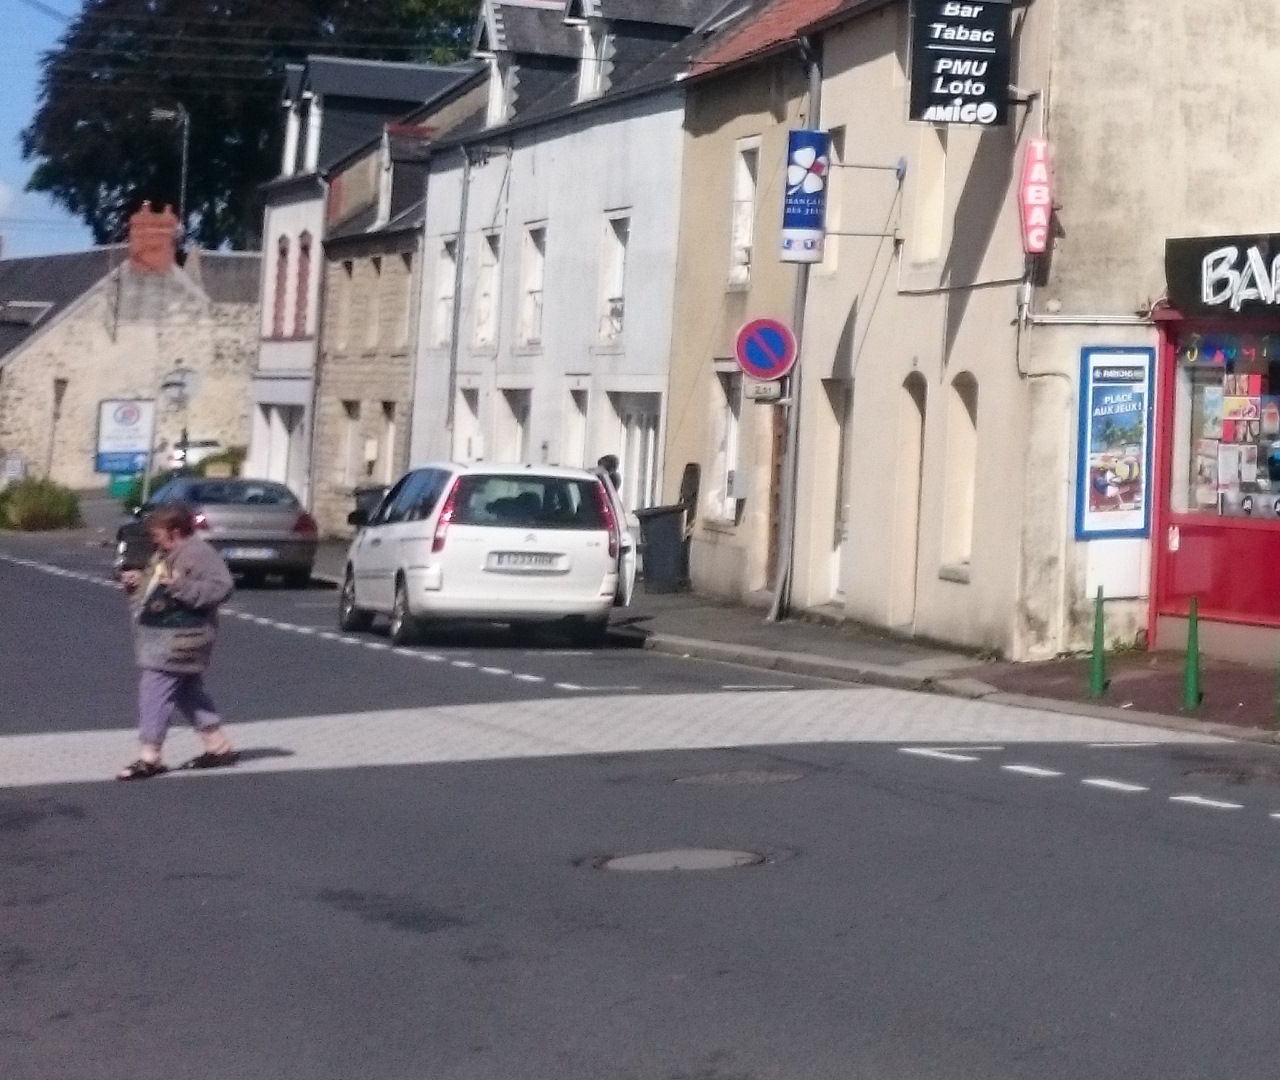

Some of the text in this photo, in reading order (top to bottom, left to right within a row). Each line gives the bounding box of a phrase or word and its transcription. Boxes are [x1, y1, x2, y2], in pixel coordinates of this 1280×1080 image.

[942, 1, 984, 18] Bar
[929, 22, 995, 42] Tabac
[936, 58, 988, 76] PMU
[933, 76, 986, 95] Loto
[1028, 141, 1050, 249] TABAC
[1104, 394, 1133, 404] PLACE
[1093, 405, 1114, 416] AUX
[1115, 403, 1137, 414] JEUX
